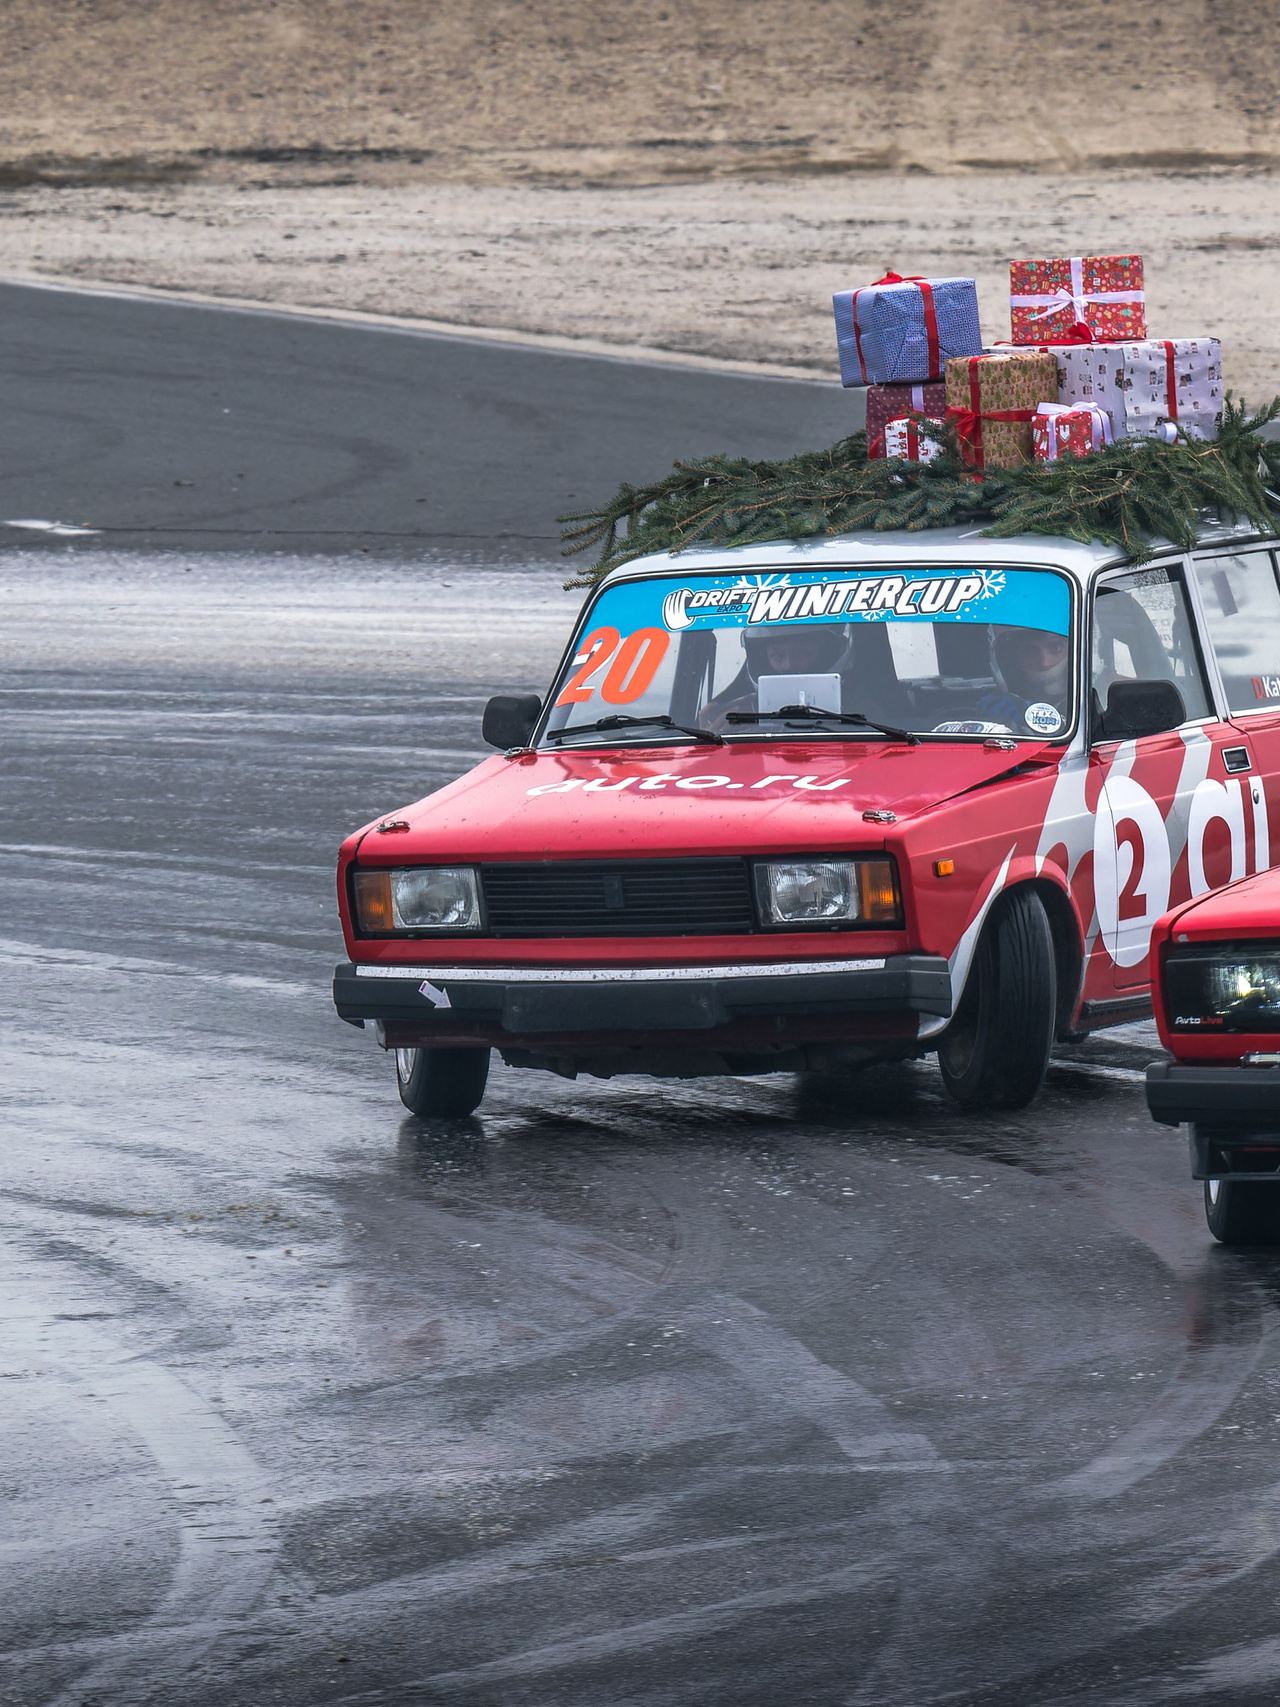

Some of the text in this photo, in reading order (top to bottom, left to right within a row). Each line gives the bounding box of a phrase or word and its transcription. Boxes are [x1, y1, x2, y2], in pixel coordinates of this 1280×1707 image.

[688, 587, 759, 608] DRIFT
[716, 604, 743, 613] EXPO
[555, 625, 670, 708] 20
[525, 773, 852, 796] auto.ru
[1115, 817, 1147, 921] 2
